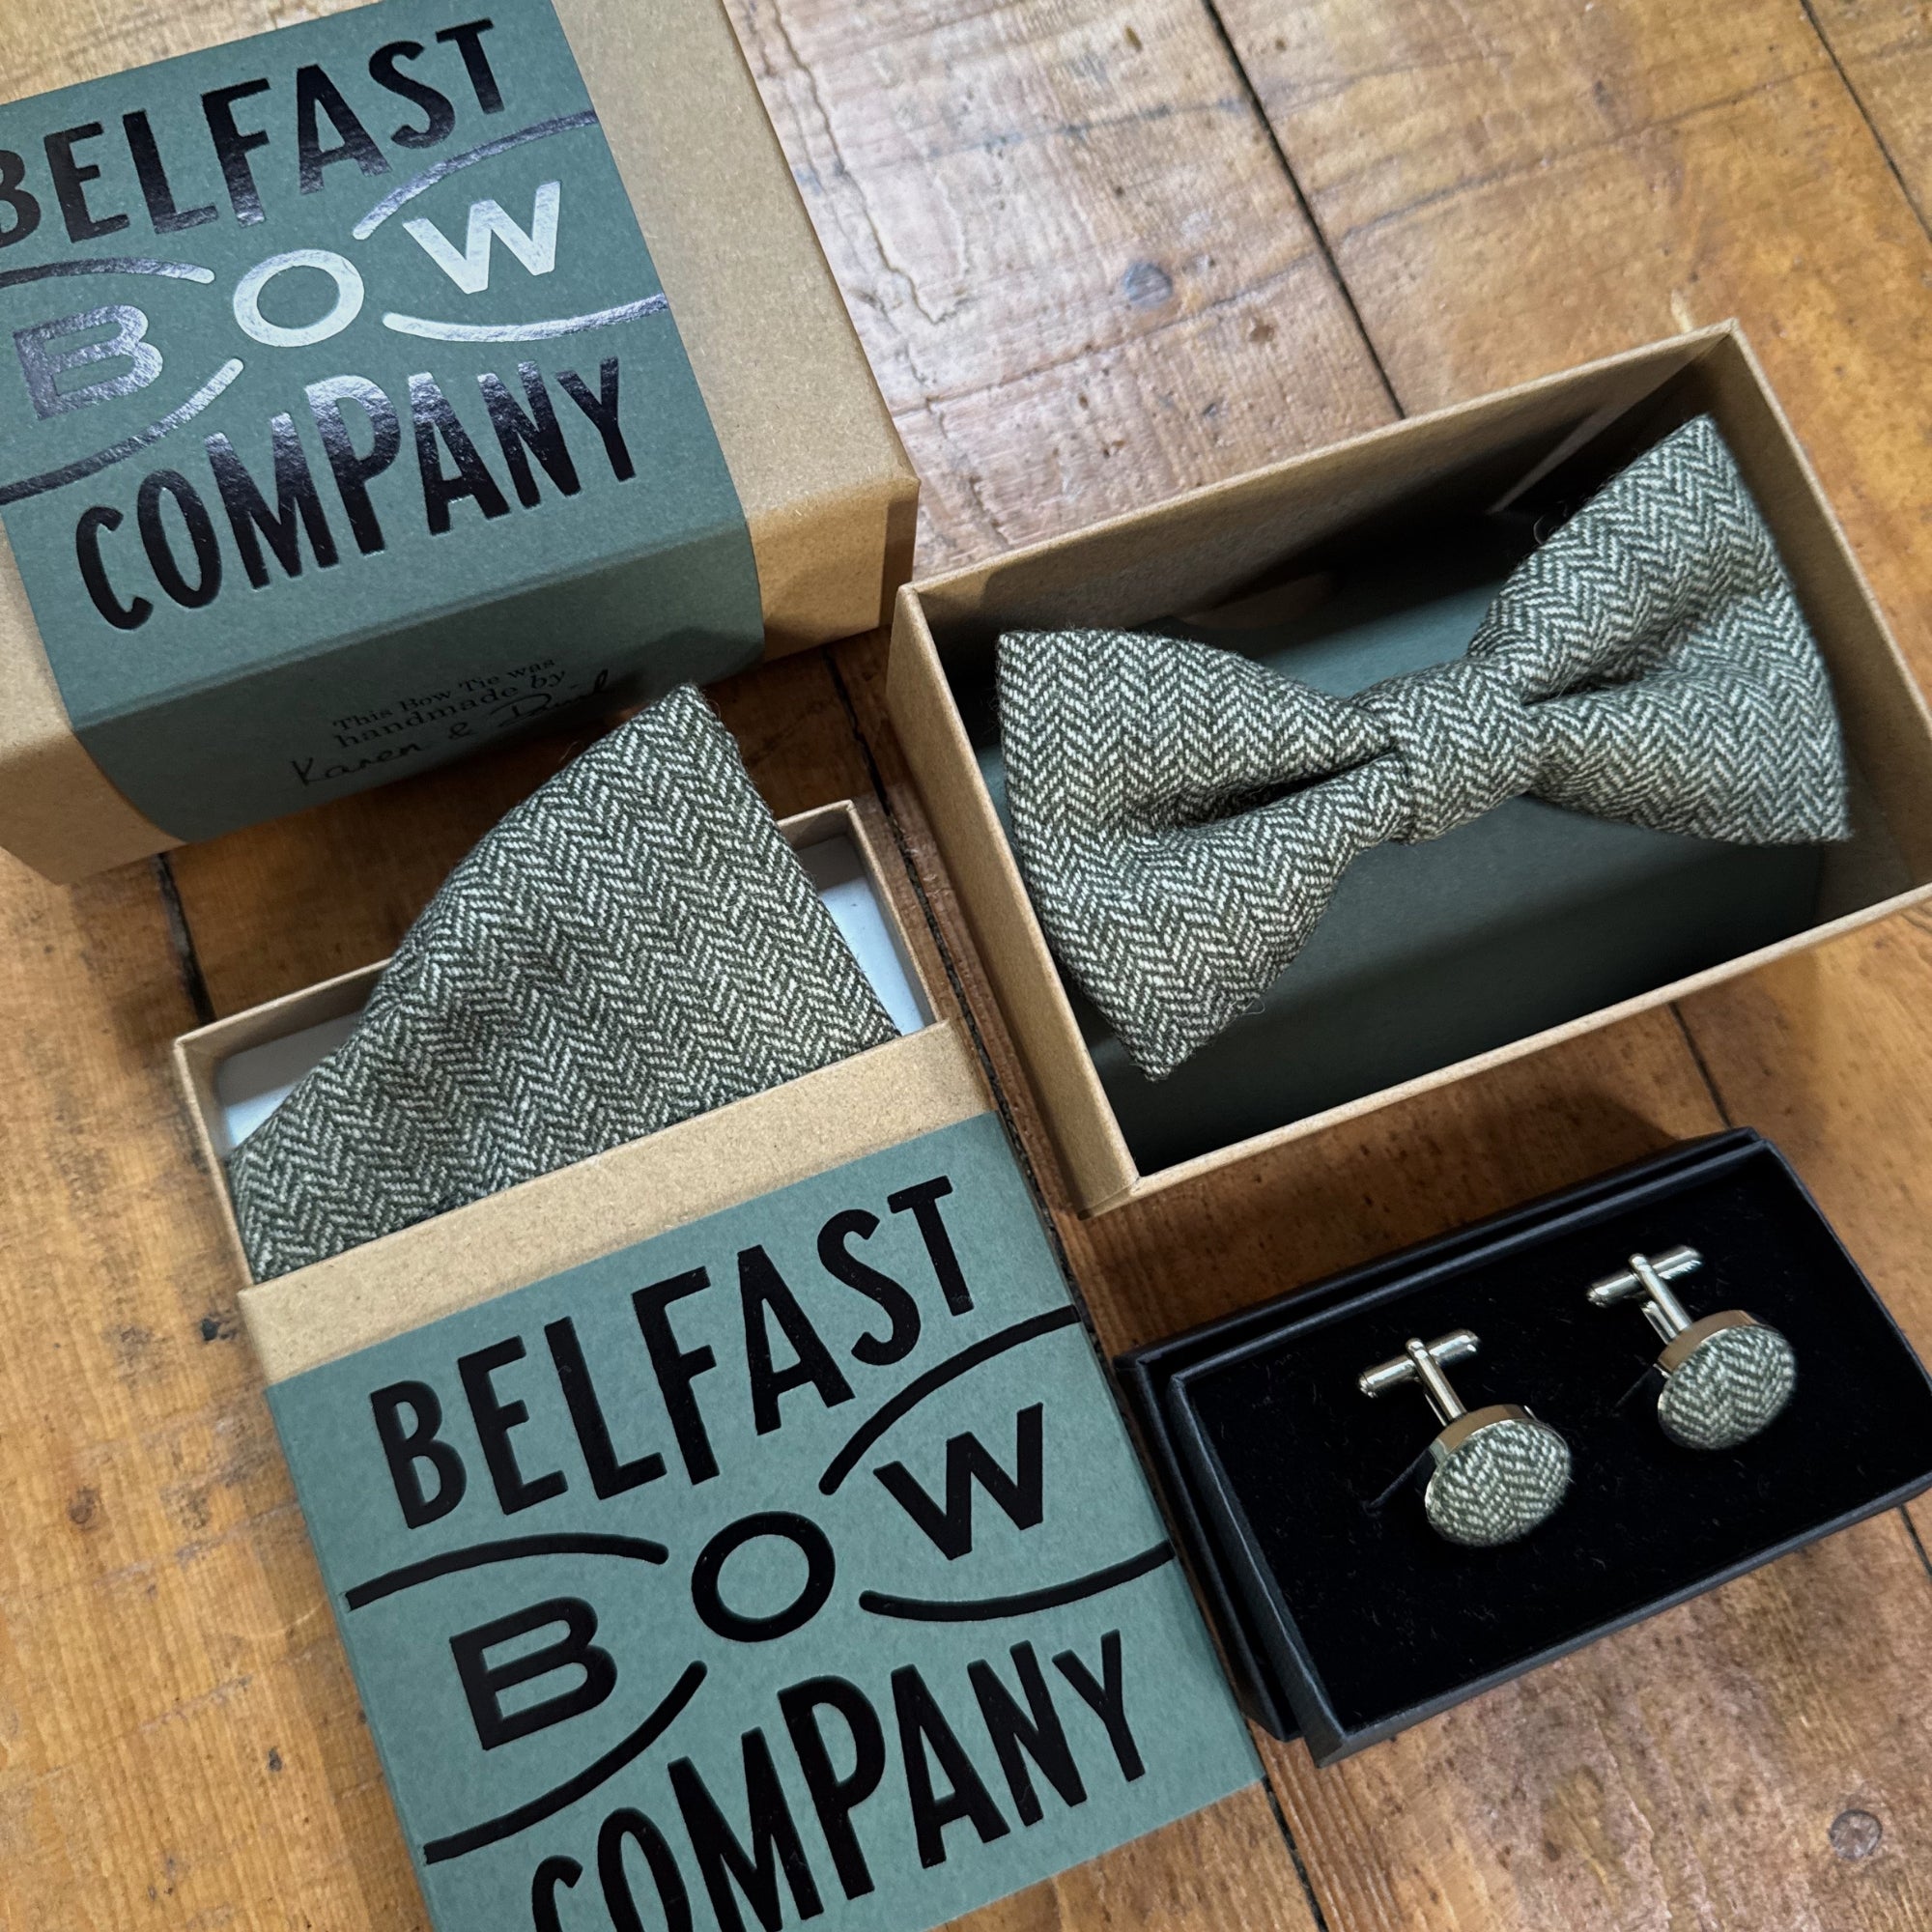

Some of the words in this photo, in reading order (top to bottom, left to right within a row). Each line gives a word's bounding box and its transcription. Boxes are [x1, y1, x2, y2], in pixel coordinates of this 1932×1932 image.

[0, 19, 504, 248] BELFAST
[13, 181, 561, 422] BOW
[75, 357, 636, 631] COMPANY
[290, 741, 424, 786] Karen
[333, 707, 392, 732] This
[399, 689, 452, 710] Bow
[459, 673, 500, 694] Tie
[505, 658, 556, 679] was
[333, 685, 519, 749] handmade
[529, 668, 566, 692] by
[370, 1175, 975, 1529] BELFAST
[449, 1402, 1044, 1750] BOW
[531, 1629, 1146, 1932] COMPANY
